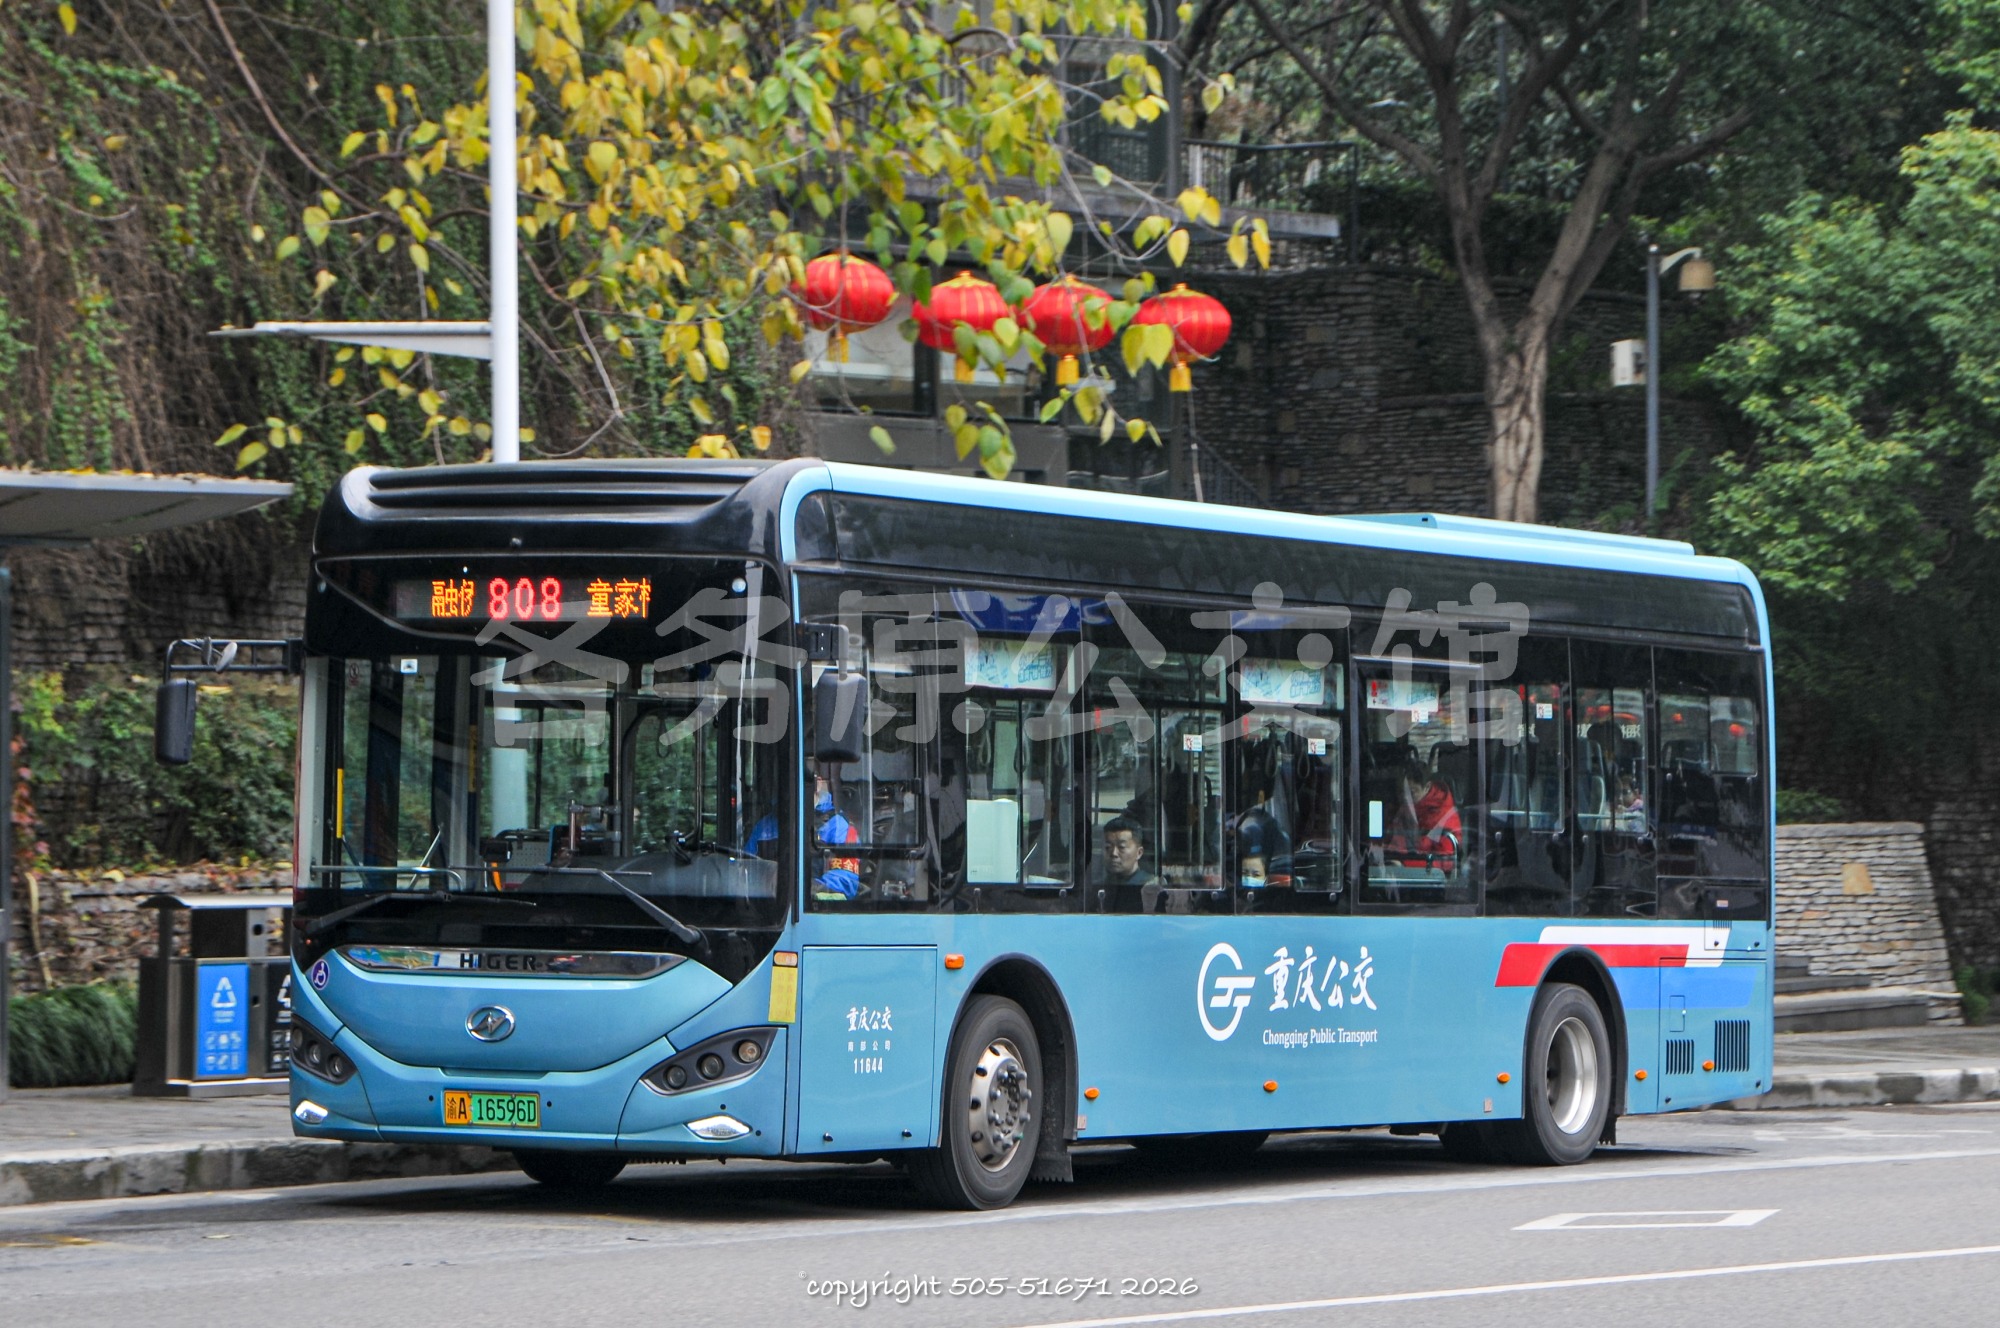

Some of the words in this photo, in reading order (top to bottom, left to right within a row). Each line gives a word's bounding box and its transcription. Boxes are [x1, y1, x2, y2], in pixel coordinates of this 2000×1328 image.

[488, 577, 561, 619] 808
[460, 953, 537, 971] HIGER
[1264, 946, 1378, 1012] 重庆公交
[846, 1006, 893, 1032] 重庆公交
[1263, 1028, 1309, 1049] Chongqing
[1310, 1028, 1336, 1044] Public
[1338, 1027, 1378, 1047] Transport
[853, 1057, 883, 1074] 11644
